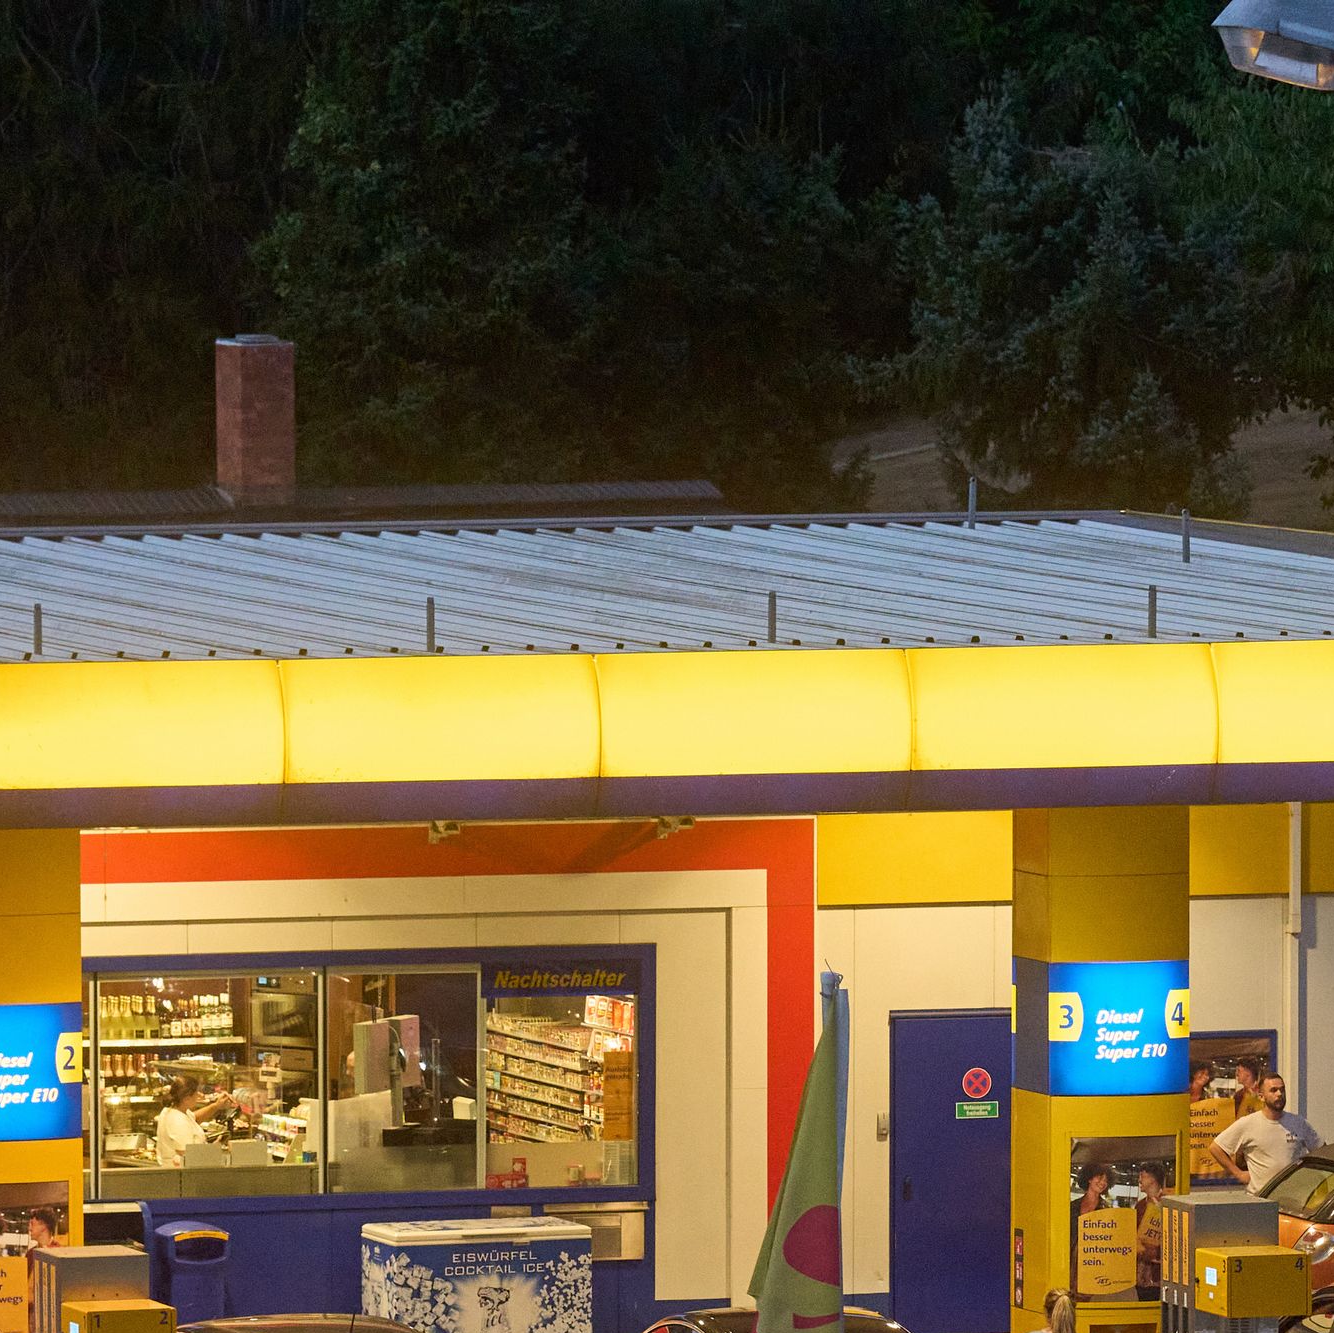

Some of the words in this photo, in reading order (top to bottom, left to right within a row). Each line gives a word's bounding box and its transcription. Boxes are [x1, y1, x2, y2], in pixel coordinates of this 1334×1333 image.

[494, 969, 627, 988] Nachtschalter
[1059, 1005, 1074, 1029] 3
[1095, 1008, 1144, 1024] Diesel
[1171, 1001, 1185, 1026] 4
[1095, 1028, 1140, 1046] Super
[63, 1046, 75, 1070] 2
[1095, 1045, 1140, 1063] Super
[1141, 1043, 1167, 1058] E10
[31, 1087, 59, 1103] E10
[1083, 1220, 1117, 1229] Einfach
[1083, 1232, 1113, 1241] besser
[452, 1250, 537, 1263] EISWÜRFEL
[1083, 1245, 1133, 1254] unterwegs
[1083, 1258, 1105, 1266] sein.
[1234, 1259, 1243, 1273] 3
[1294, 1257, 1305, 1271] 4
[444, 1264, 516, 1276] COCKTAIL
[522, 1263, 546, 1274] ICE
[95, 1314, 101, 1328] 1
[159, 1311, 169, 1325] 2
